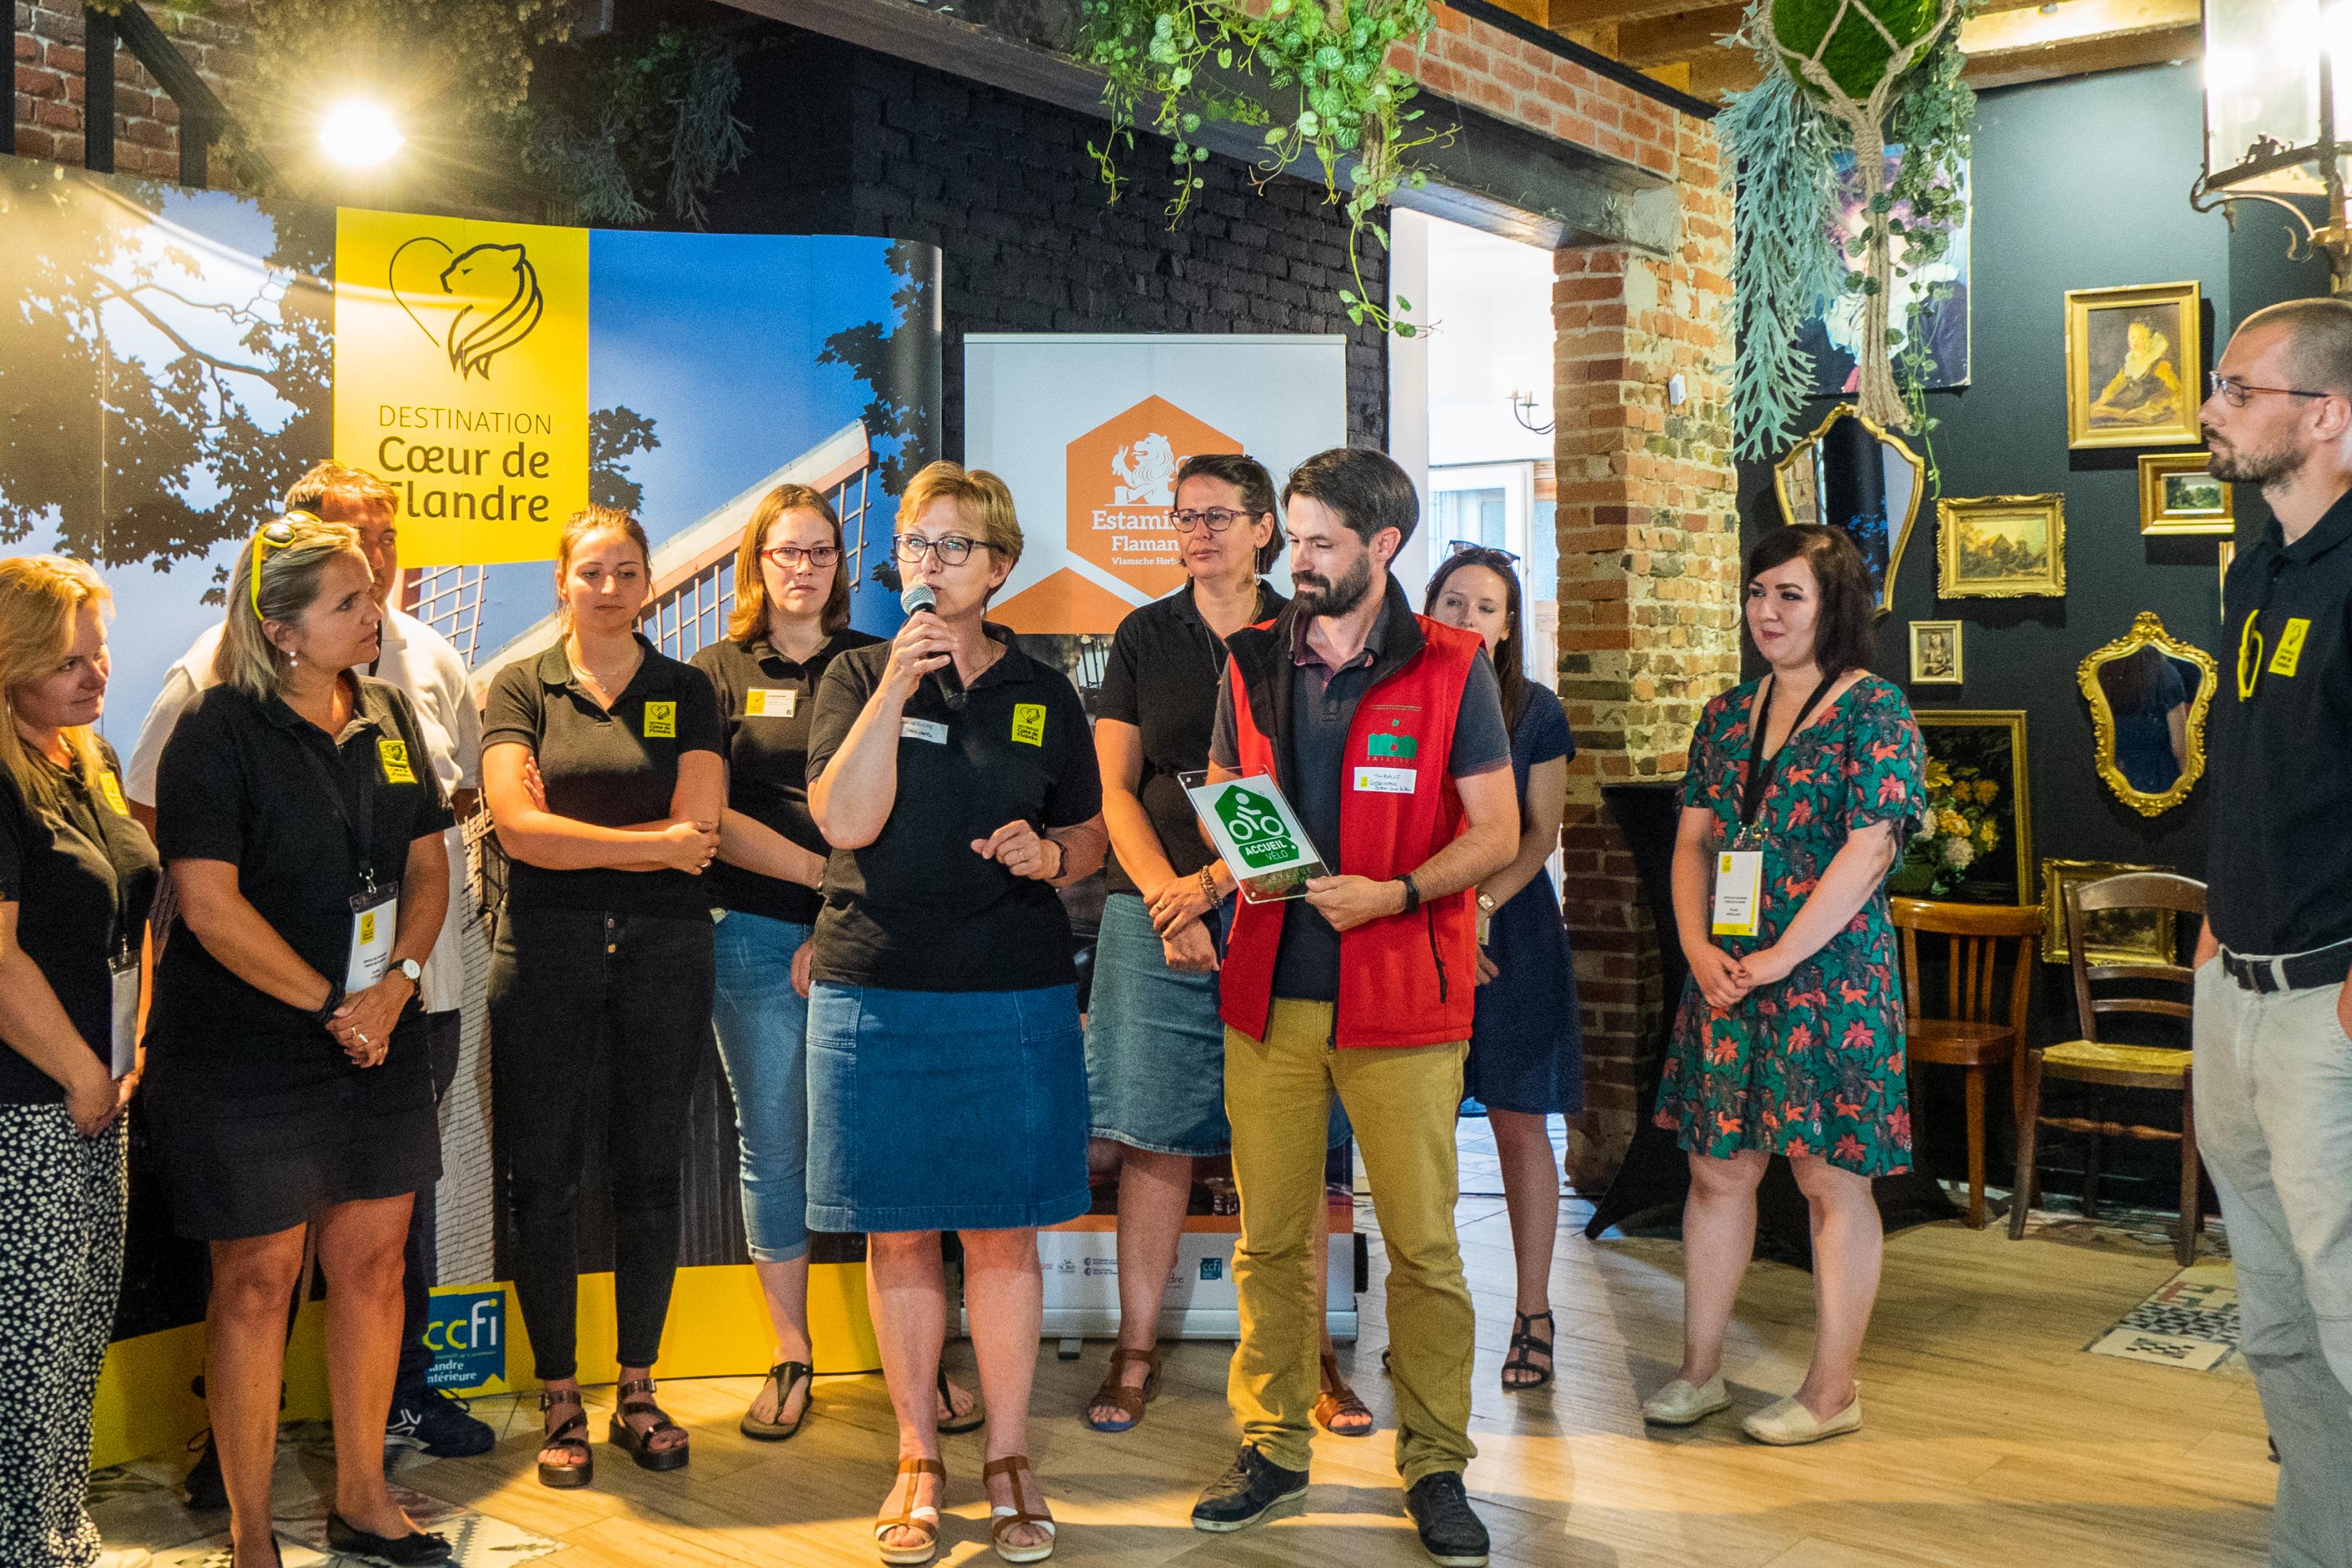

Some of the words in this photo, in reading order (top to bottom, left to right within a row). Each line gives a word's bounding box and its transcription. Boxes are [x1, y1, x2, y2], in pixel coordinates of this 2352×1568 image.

[380, 405, 551, 435] DESTINATION
[378, 436, 491, 476] Cœur
[502, 441, 550, 478] de
[1092, 510, 1175, 530] Estami
[1245, 840, 1287, 856] ACCUEIL
[1265, 850, 1289, 861] VÉLO
[422, 1298, 498, 1351] ccfi
[430, 1360, 464, 1372] andre
